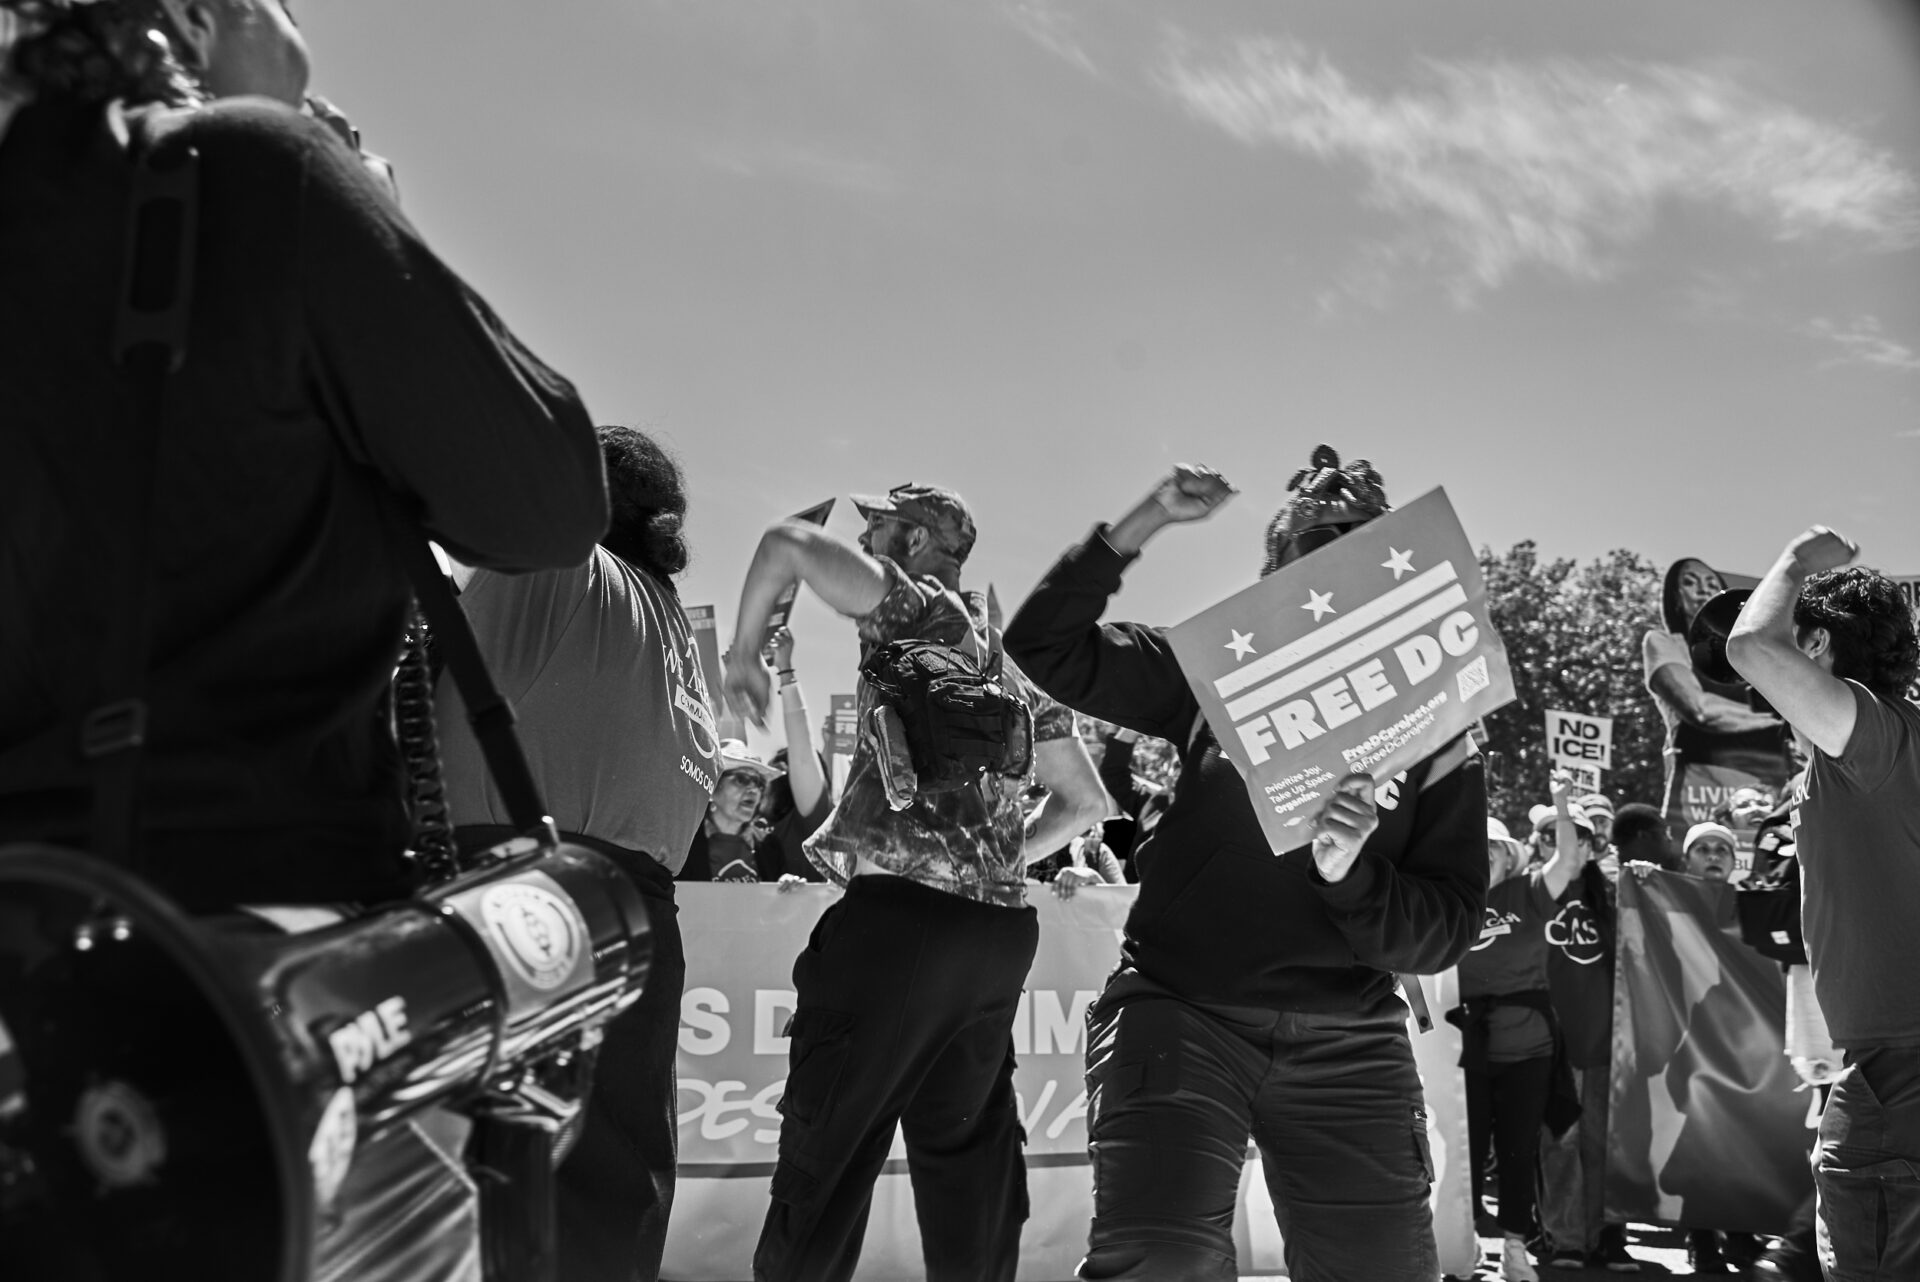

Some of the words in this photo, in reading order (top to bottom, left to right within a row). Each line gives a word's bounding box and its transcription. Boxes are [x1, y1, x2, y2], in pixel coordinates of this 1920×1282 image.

[1235, 657, 1398, 766] FREE
[1393, 611, 1479, 686] DC
[1559, 718, 1600, 740] NO
[1553, 737, 1606, 761] ICE!
[680, 755, 704, 785] SOMOS
[1265, 771, 1304, 795] Prioritize
[1269, 787, 1292, 805] Take
[1292, 782, 1307, 797] Up
[1687, 785, 1735, 804] LIVI
[1544, 917, 1600, 946] CAS
[678, 986, 731, 1056] S
[753, 988, 798, 1056] D
